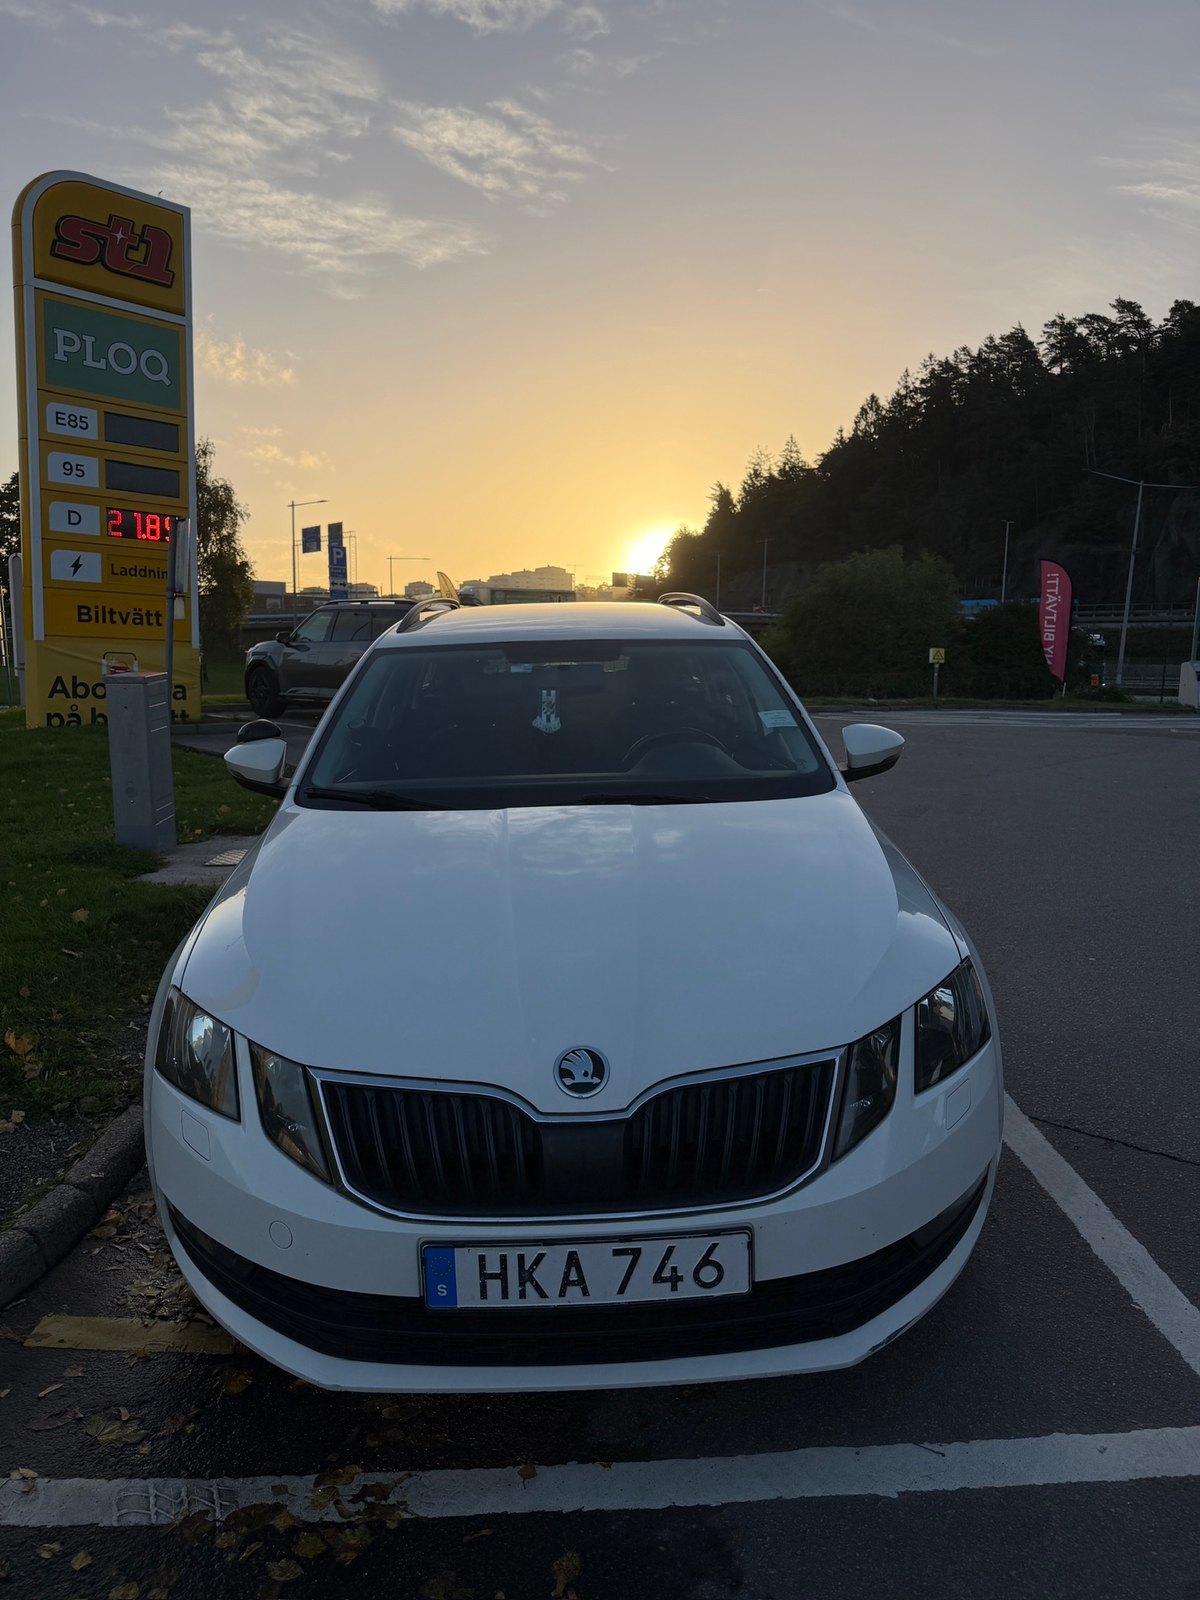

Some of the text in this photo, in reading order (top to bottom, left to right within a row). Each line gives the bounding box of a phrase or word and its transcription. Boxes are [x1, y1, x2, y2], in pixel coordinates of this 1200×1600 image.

[53, 327, 172, 386] PLOQ
[55, 411, 89, 431] E85
[62, 461, 86, 478] 95
[67, 510, 82, 526] D
[333, 548, 344, 565] P
[111, 563, 168, 580] Laddnin
[77, 605, 163, 627] Biltvätt
[47, 675, 187, 701] Aboa
[478, 1242, 725, 1300] HKA 746
[437, 1284, 448, 1297] S
